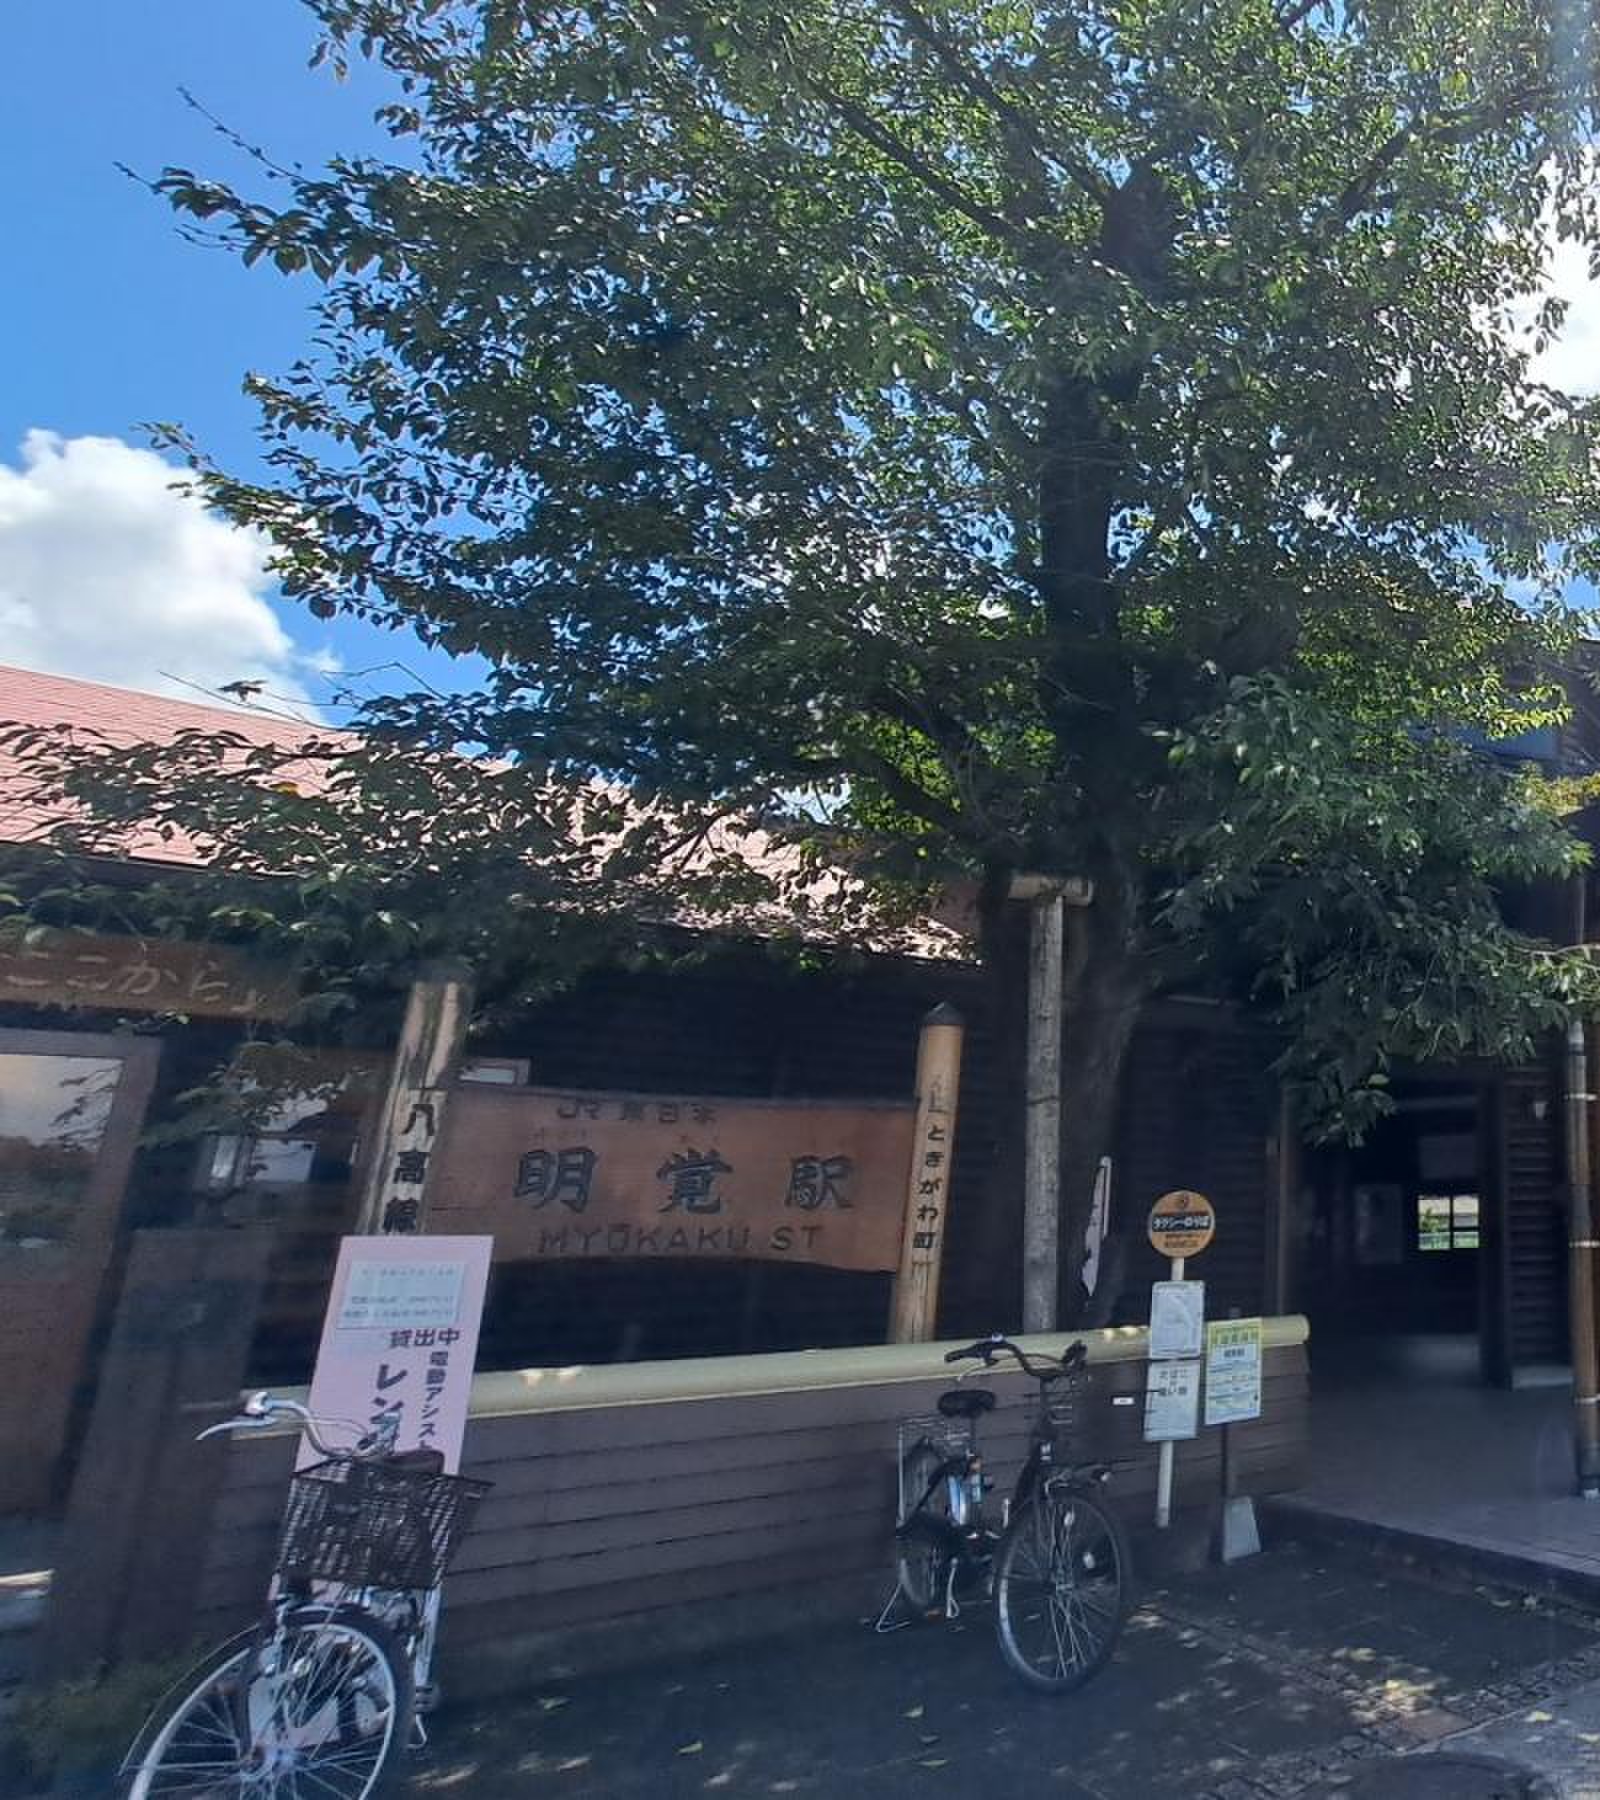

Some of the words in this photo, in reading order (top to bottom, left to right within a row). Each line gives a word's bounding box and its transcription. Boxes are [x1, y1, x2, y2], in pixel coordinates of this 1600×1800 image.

[383, 1102, 436, 1234] 八高線
[513, 1146, 856, 1214] 明覚駅
[913, 1124, 946, 1250] ときがわ町
[770, 1226, 824, 1252] ST
[388, 1328, 460, 1349] 貸出中
